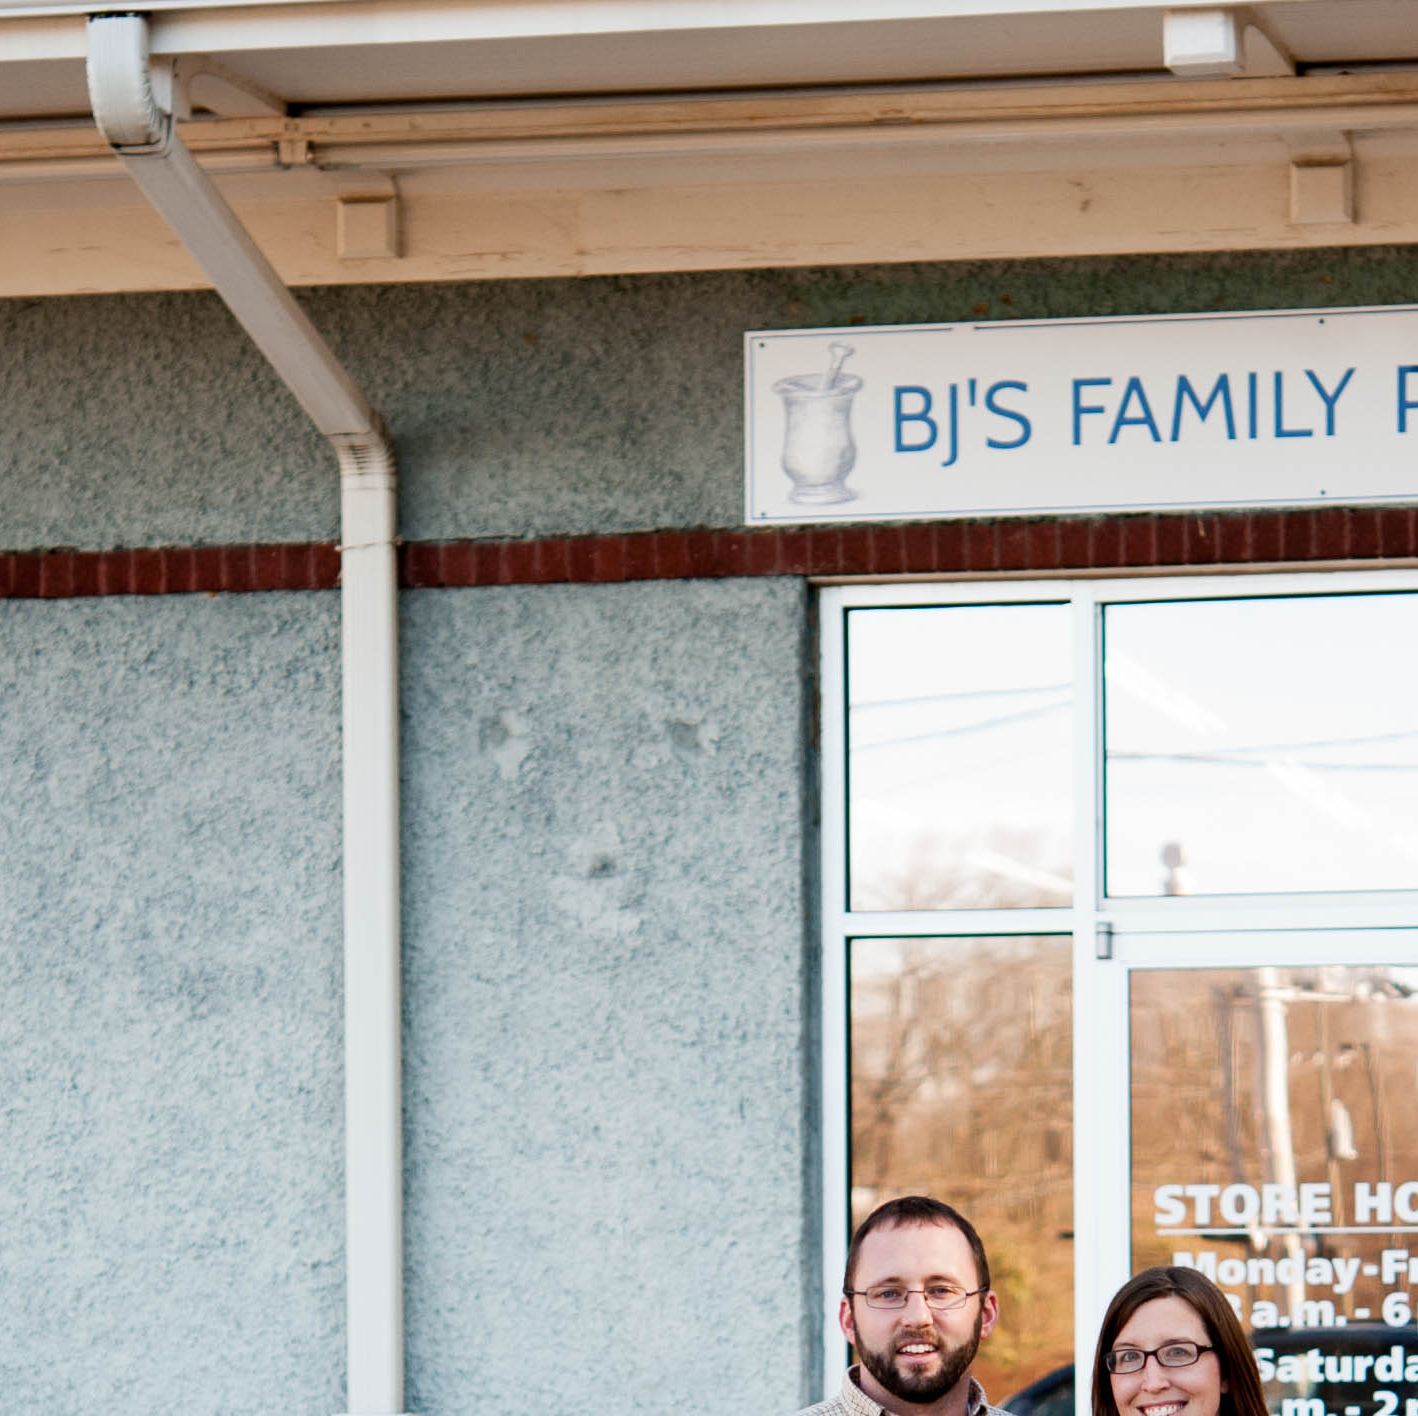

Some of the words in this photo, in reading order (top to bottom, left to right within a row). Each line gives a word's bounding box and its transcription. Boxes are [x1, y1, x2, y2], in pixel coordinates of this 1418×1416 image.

[892, 378, 1032, 467] BJ'S
[1071, 367, 1357, 446] FAMILY
[1153, 1183, 1332, 1226] STORE
